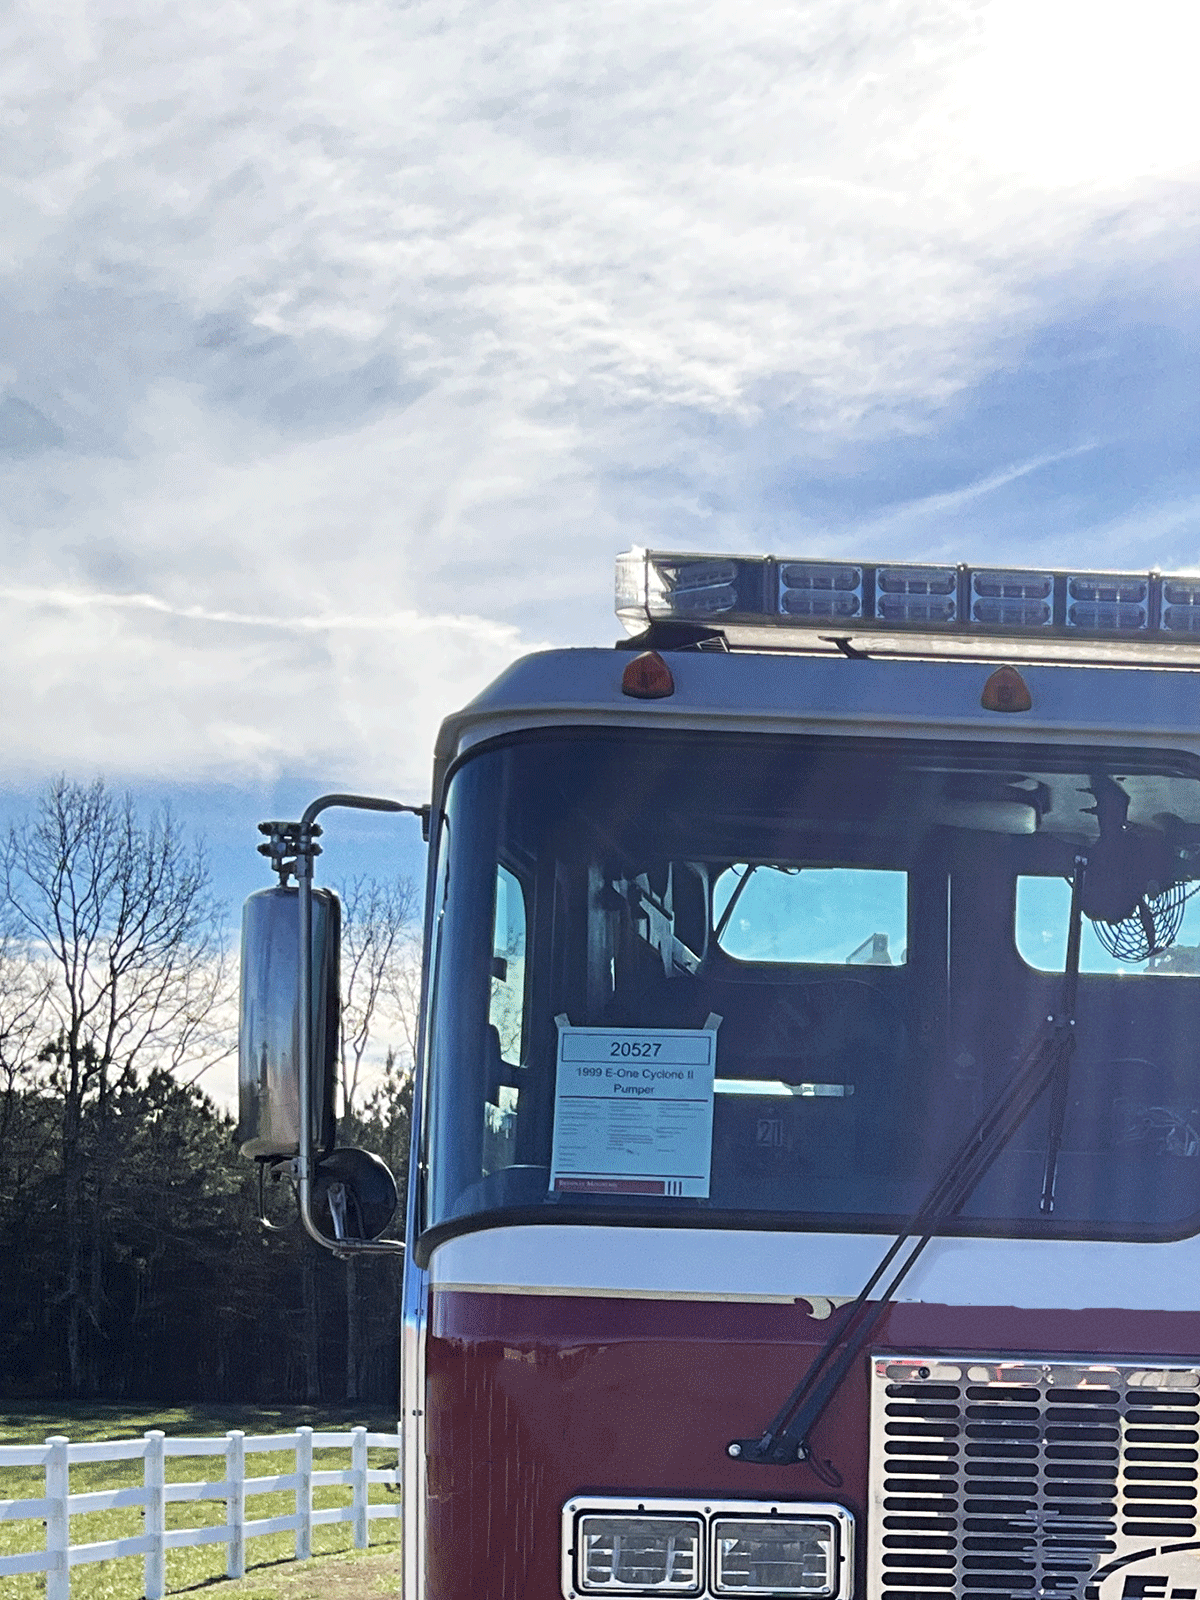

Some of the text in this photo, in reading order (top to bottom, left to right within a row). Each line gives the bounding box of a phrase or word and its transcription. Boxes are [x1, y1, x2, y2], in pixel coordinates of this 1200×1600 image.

[610, 1042, 663, 1057] 20527
[577, 1067, 603, 1077] 1999
[605, 1068, 640, 1078] E-One
[642, 1068, 684, 1081] Cyclone
[613, 1083, 655, 1096] Pumper
